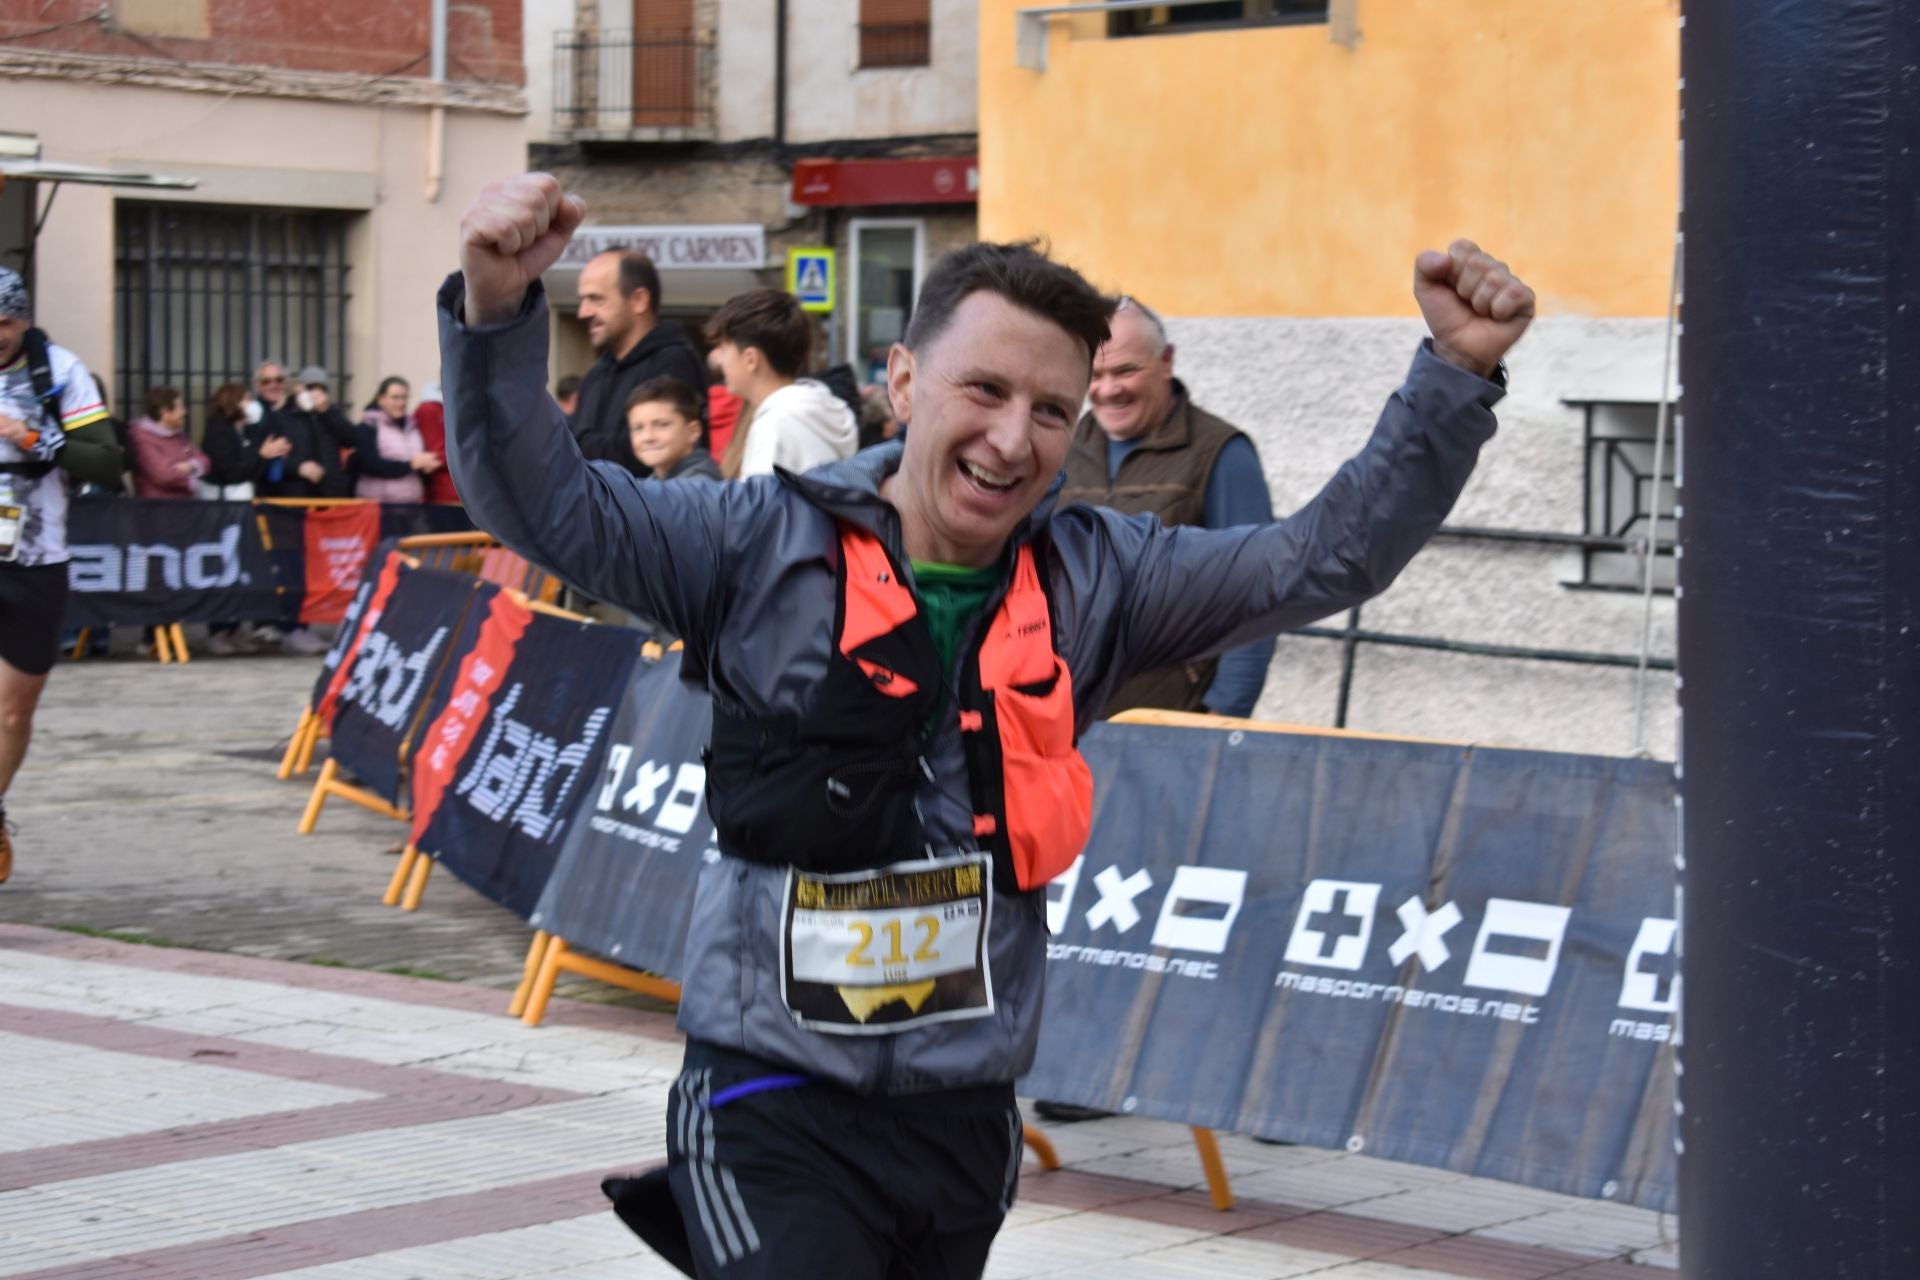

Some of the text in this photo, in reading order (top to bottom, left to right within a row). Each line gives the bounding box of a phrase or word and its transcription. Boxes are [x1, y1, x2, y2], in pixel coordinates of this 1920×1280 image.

[669, 235, 758, 264] CARMEN
[845, 913, 941, 967] 212
[1274, 971, 1541, 1024] maspormenos.net
